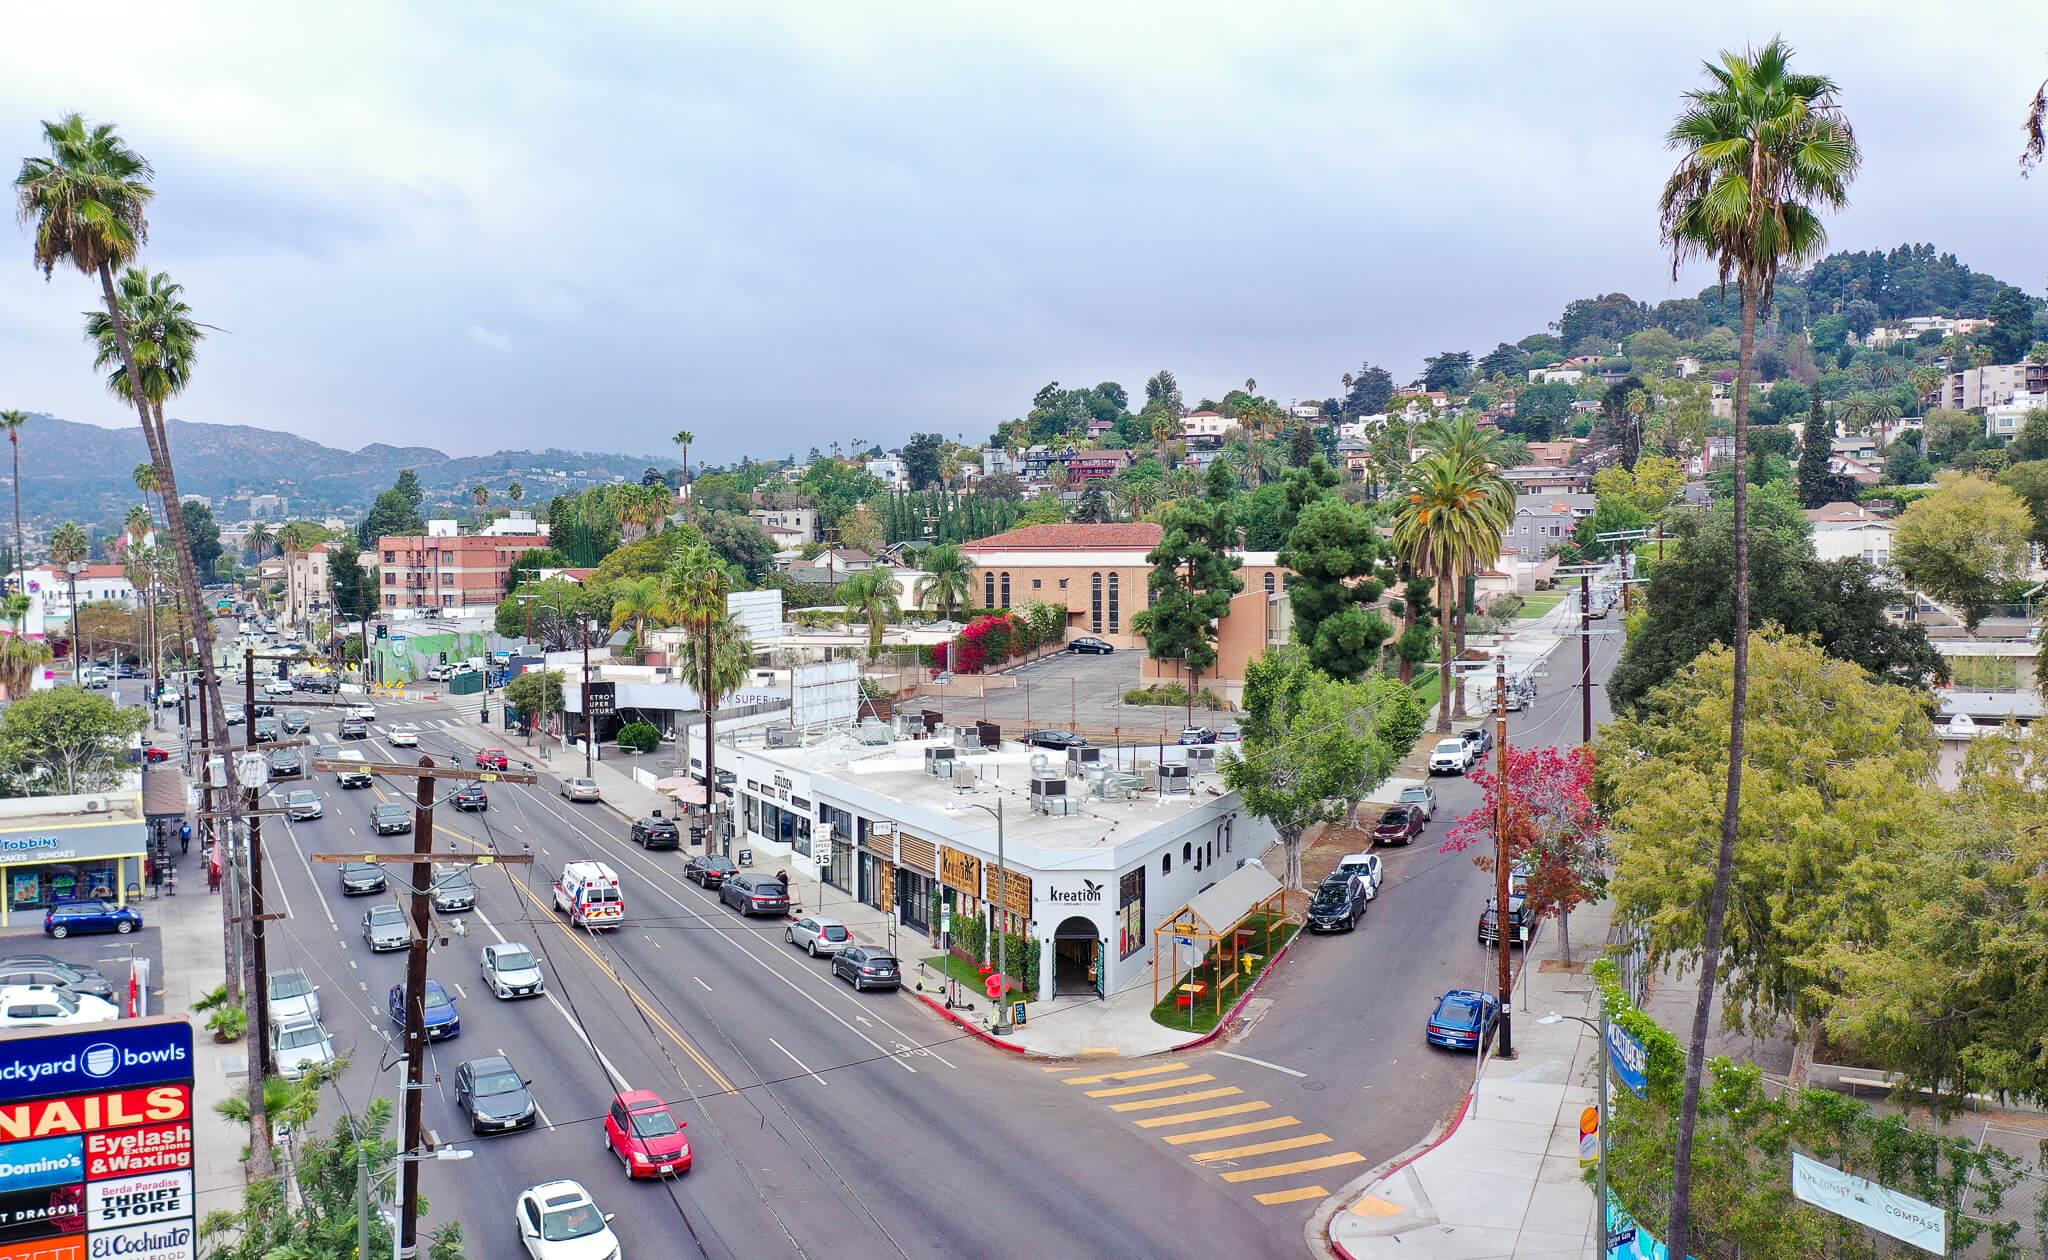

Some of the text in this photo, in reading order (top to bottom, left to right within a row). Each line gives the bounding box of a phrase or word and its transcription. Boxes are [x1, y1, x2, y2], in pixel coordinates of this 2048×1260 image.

[774, 774, 793, 790] GOLDEN
[779, 788, 789, 802] AGE
[815, 855, 830, 864] 35
[1050, 885, 1101, 902] kreation
[124, 1043, 186, 1066] bowls
[0, 1087, 185, 1139] NAILS
[89, 1126, 191, 1154] Eyelash
[123, 1141, 191, 1155] Extensions
[0, 1154, 81, 1177] Domino's
[102, 1178, 179, 1196] Berda Paradise
[102, 1187, 181, 1207] THRIFT
[16, 1203, 78, 1221] DRAGON
[103, 1199, 181, 1220] STORE
[1885, 1204, 1940, 1233] COMPASS
[113, 1227, 190, 1255] Cochinito
